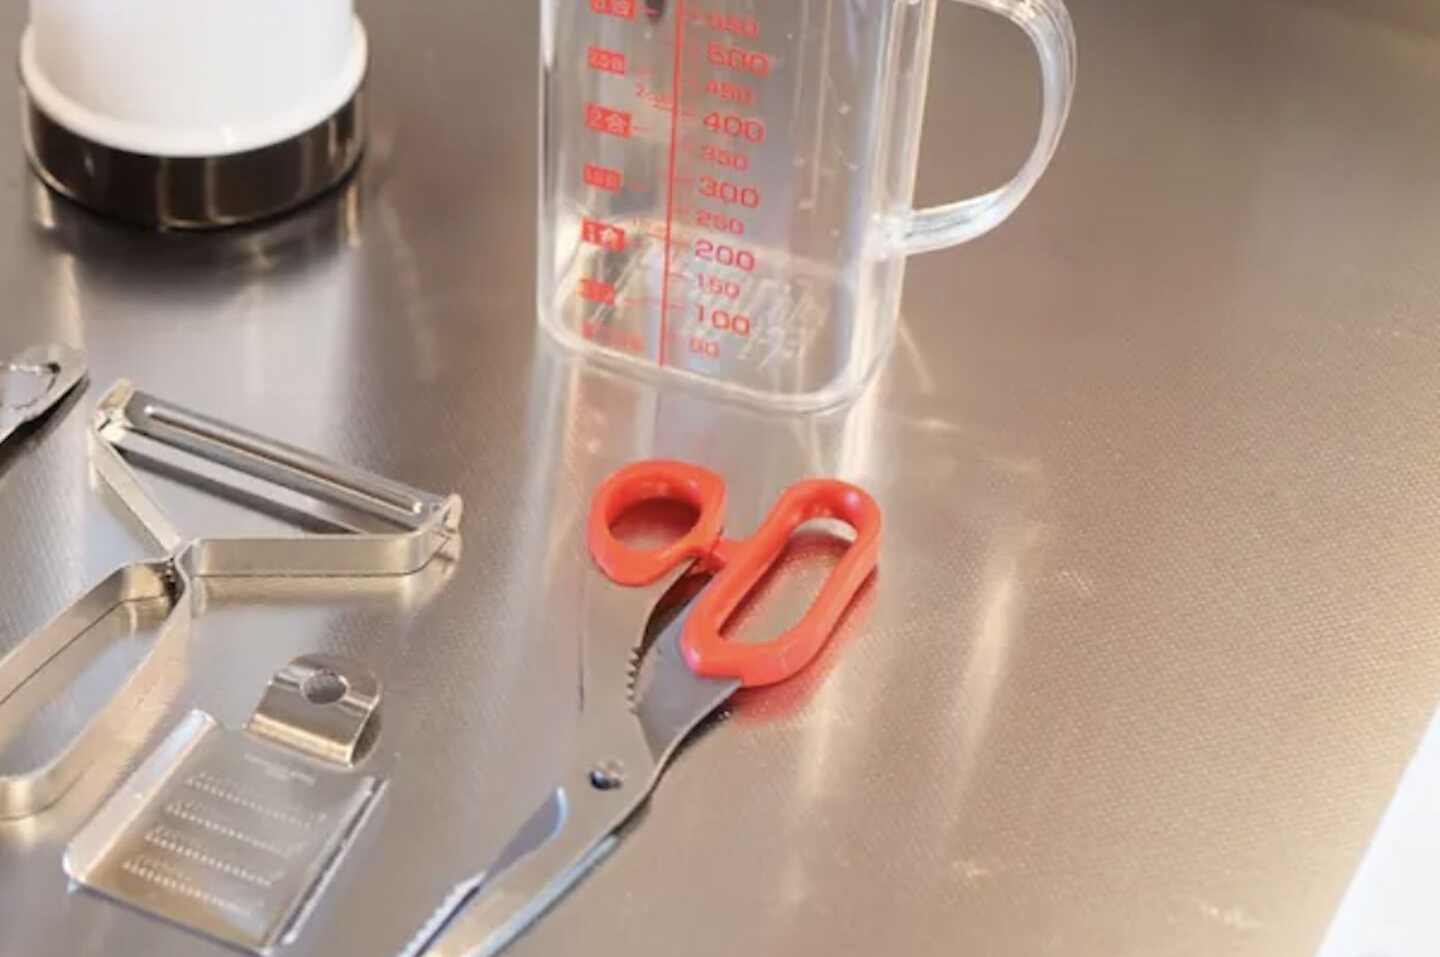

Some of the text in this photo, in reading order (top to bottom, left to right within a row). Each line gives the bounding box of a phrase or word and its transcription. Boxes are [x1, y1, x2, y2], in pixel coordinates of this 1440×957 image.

[707, 42, 769, 79] 500
[705, 78, 755, 107] 450
[703, 111, 766, 144] 400
[701, 144, 750, 172] 350
[699, 175, 760, 210] 300
[696, 209, 746, 236] 250
[695, 239, 756, 273] 200
[697, 272, 741, 300] 150
[696, 303, 751, 337] 100
